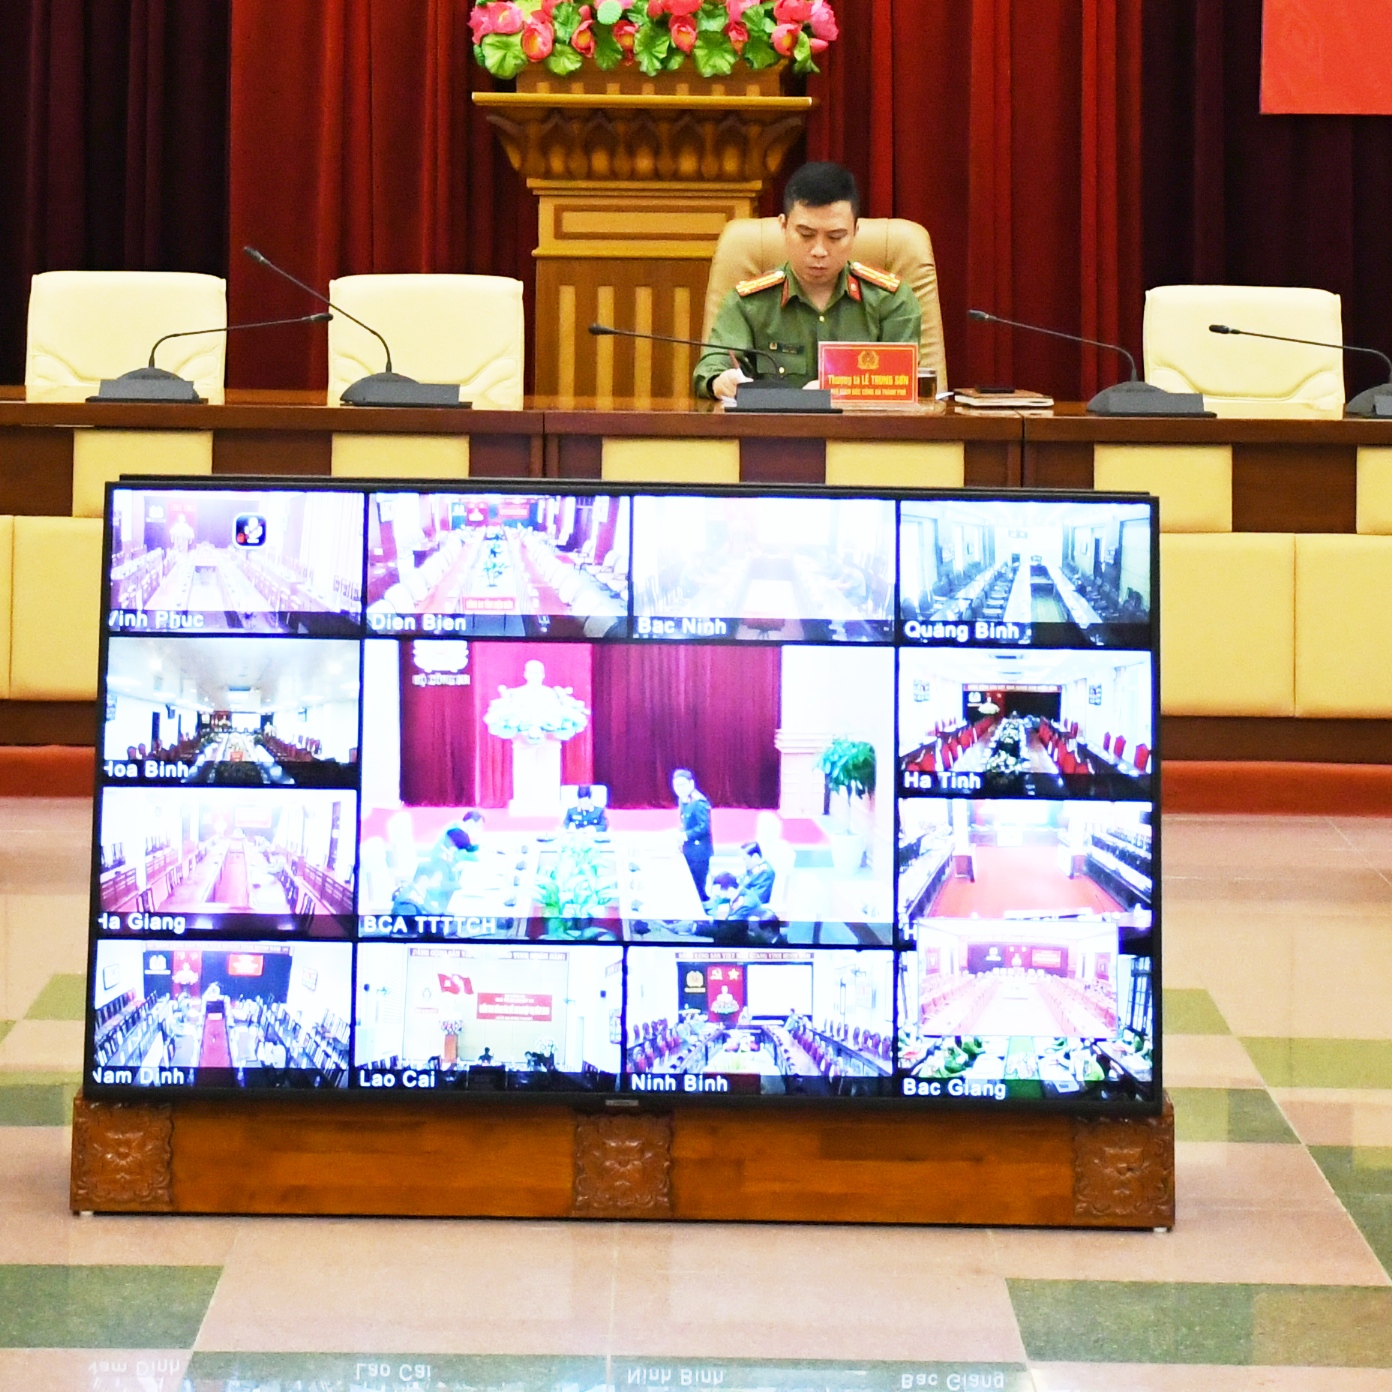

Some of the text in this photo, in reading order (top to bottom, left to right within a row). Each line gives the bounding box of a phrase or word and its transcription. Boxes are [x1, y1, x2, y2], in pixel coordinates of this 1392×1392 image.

[155, 611, 205, 629] Phuc
[372, 614, 467, 633] Dien Bien
[637, 617, 727, 635] Bac Ninh
[904, 620, 1020, 642] Quang Binh
[144, 760, 189, 778] Binh
[904, 772, 981, 790] Ha Tinh
[127, 912, 186, 935] Giang
[363, 916, 496, 935] BCA TTTTCH
[139, 1066, 185, 1085] Dinh
[359, 1070, 436, 1088] Lao Cai
[631, 1074, 729, 1093] Ninh Binh
[903, 1078, 1007, 1100] Bac Giang
